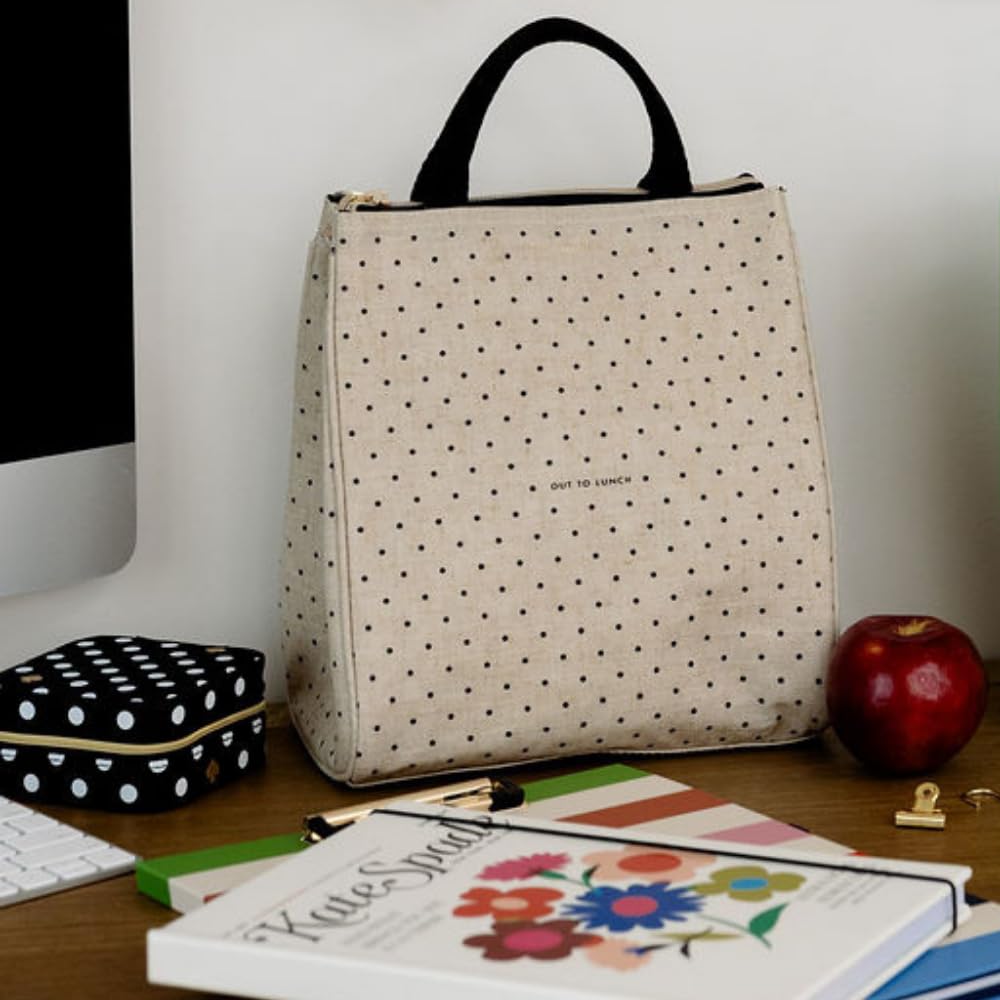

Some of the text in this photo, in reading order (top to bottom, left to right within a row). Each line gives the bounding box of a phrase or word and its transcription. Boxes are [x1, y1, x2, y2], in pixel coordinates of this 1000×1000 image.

[550, 476, 632, 490] OUT TO LUNCH
[244, 880, 380, 943] Kate
